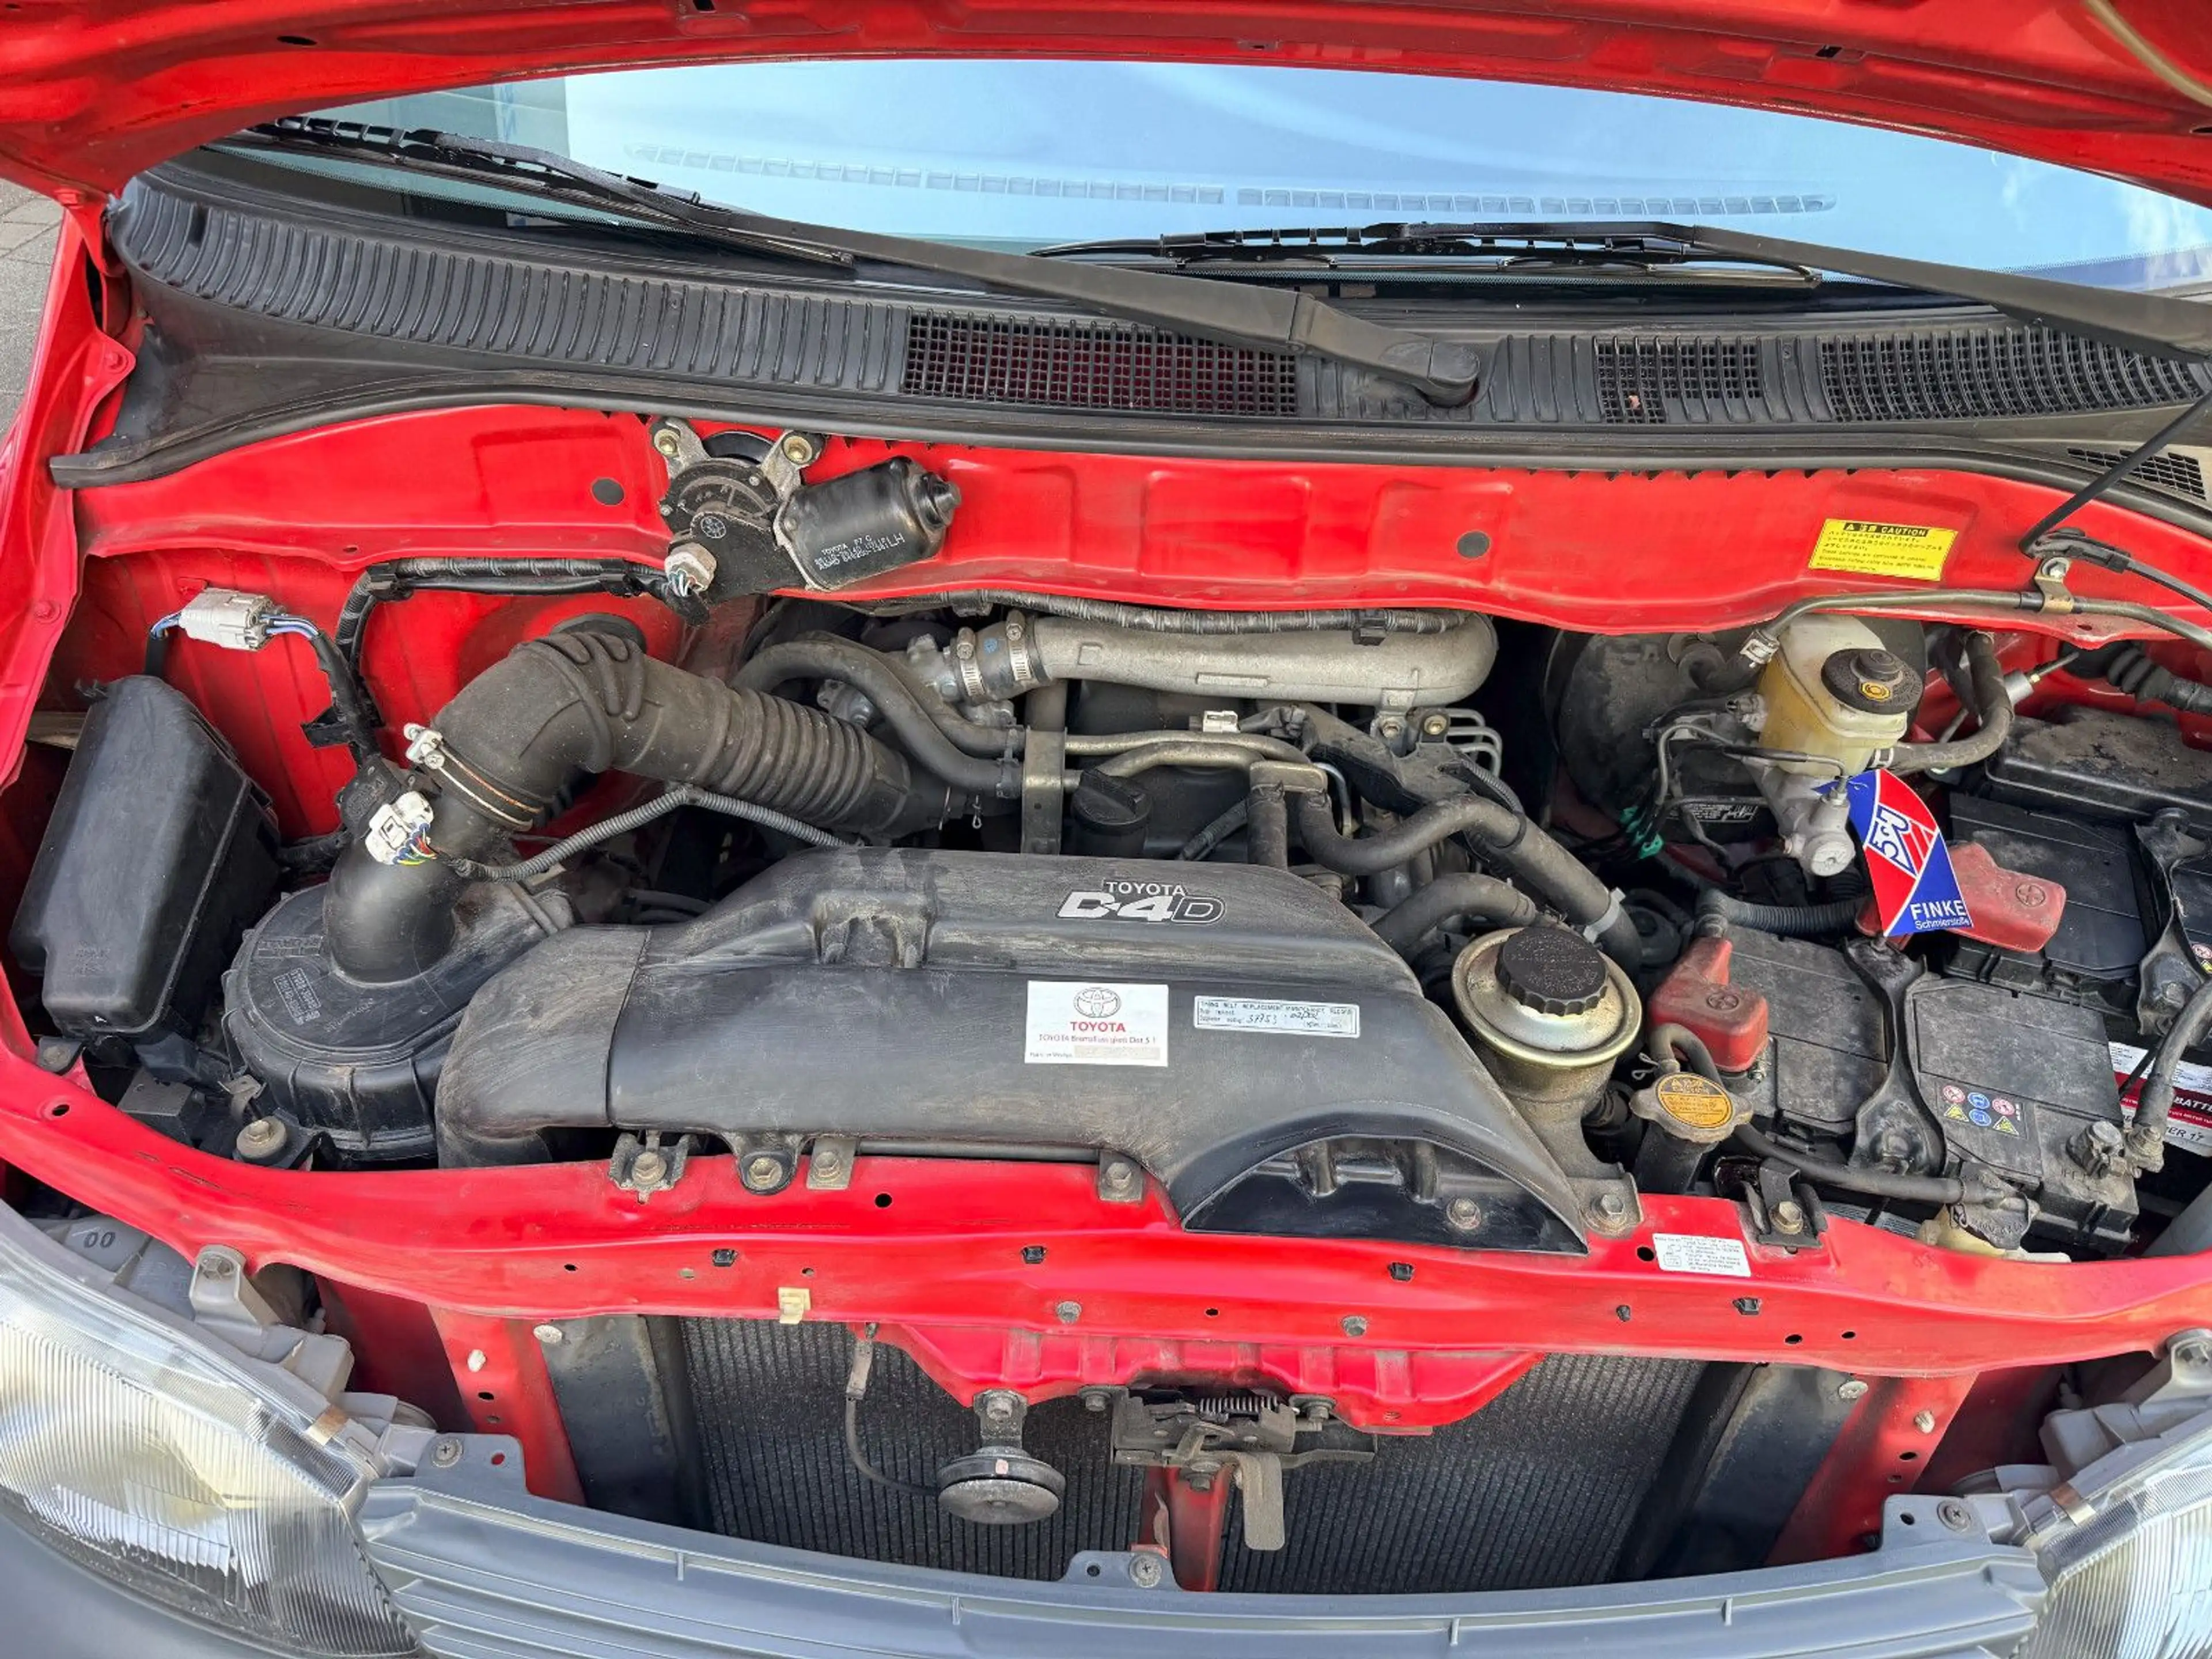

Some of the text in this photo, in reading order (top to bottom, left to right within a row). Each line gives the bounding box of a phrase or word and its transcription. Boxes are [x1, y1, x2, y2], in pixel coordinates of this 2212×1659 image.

[1881, 527, 1926, 537] CAUTION
[1105, 881, 1185, 897] TOYOTA
[1910, 900, 1966, 920] FINKE
[1070, 1021, 1126, 1032] TOYOTA
